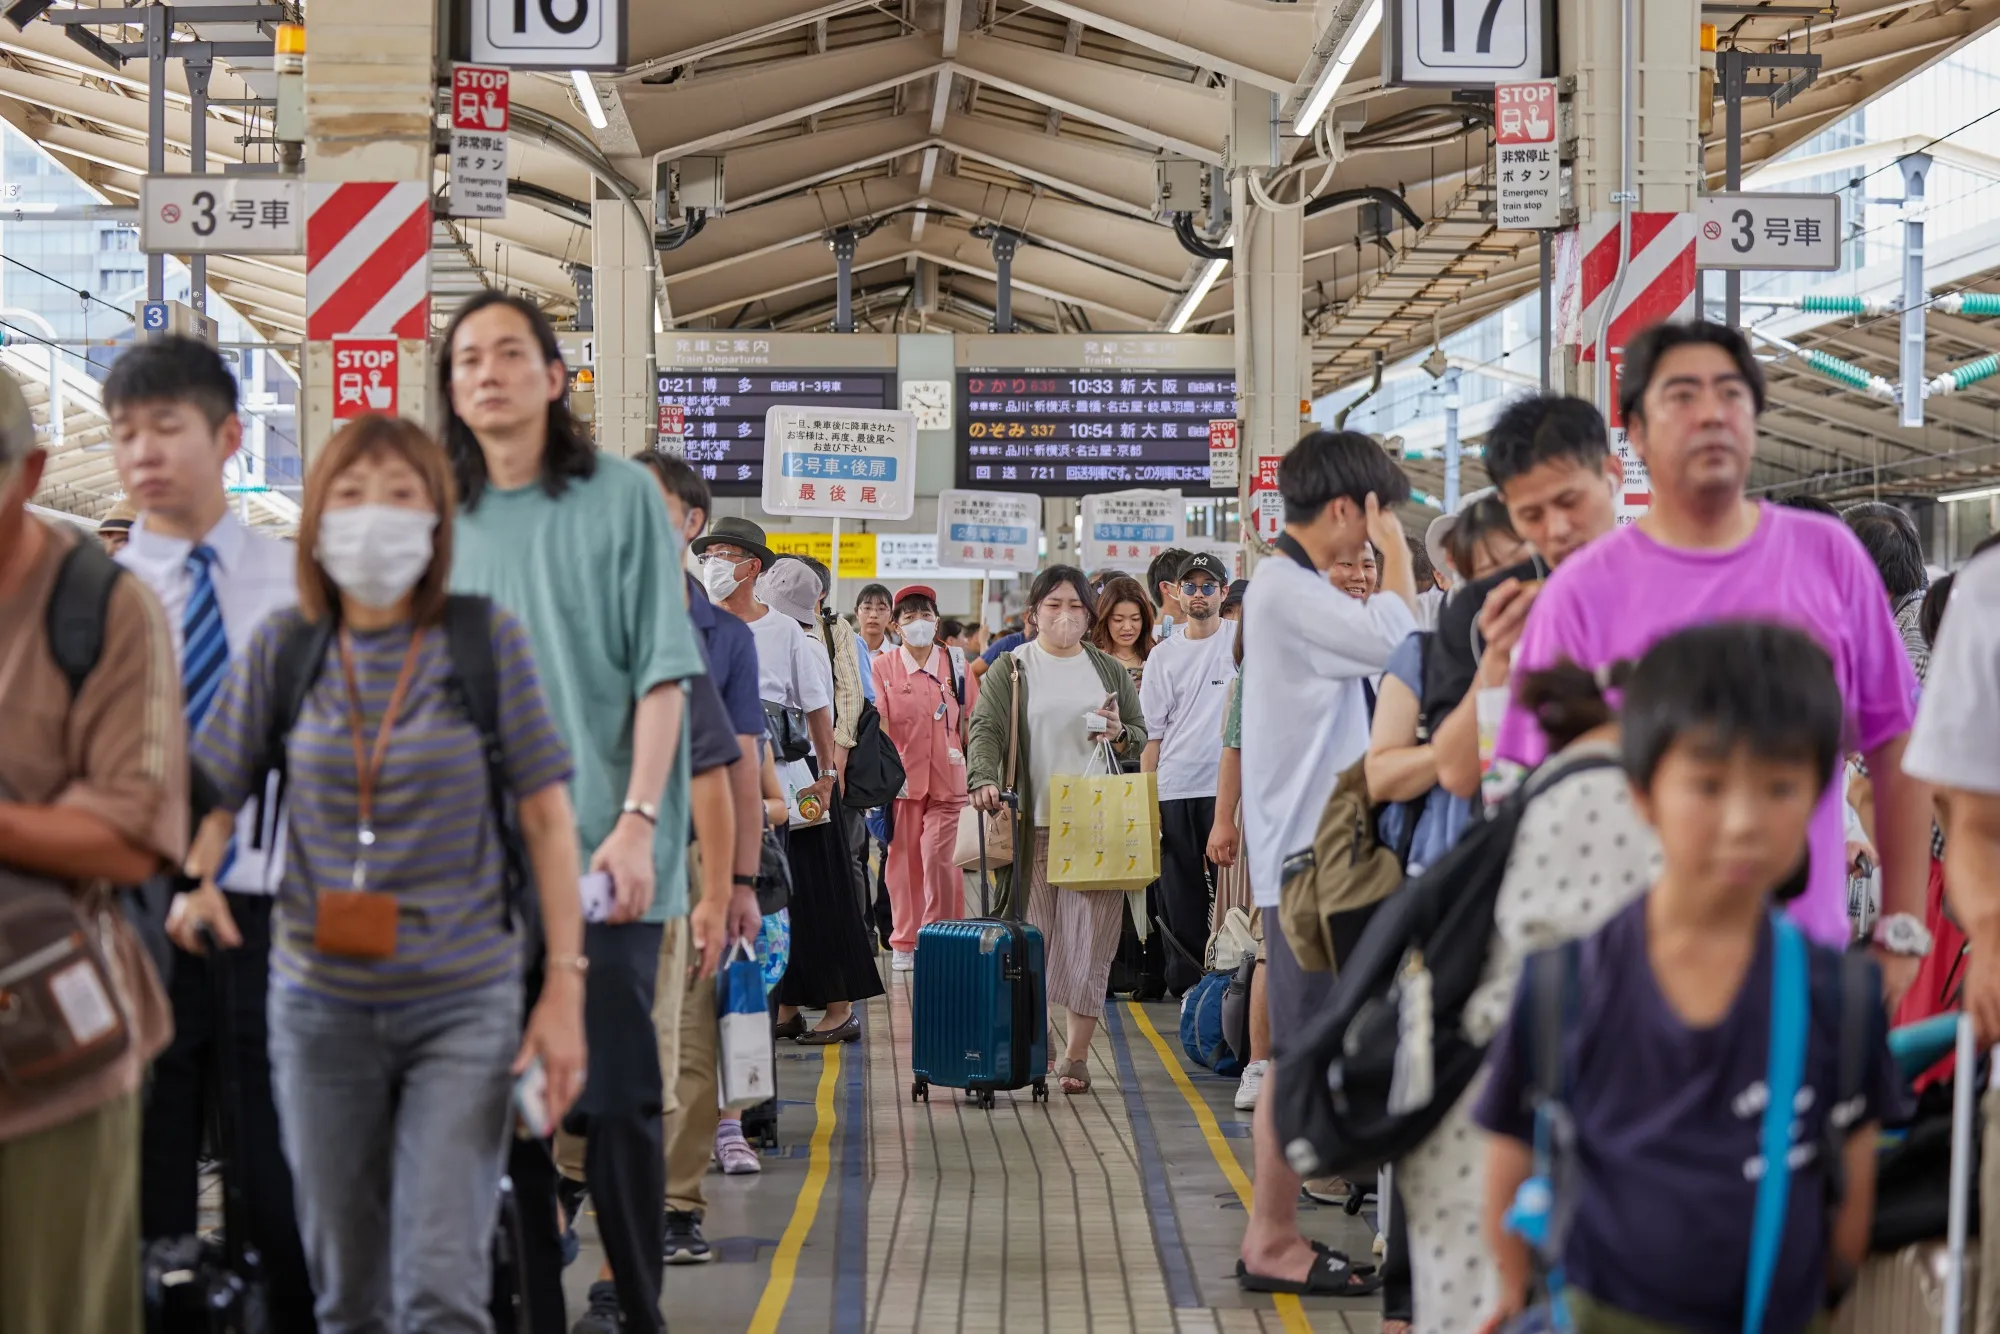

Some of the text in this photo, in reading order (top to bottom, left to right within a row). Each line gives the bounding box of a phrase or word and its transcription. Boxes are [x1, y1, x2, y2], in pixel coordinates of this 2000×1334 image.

[1441, 0, 1502, 54] 17
[457, 70, 507, 90] STOP
[1499, 86, 1551, 104] STOP
[458, 135, 504, 152] 非常停止
[457, 155, 504, 171] ボタン
[1501, 149, 1551, 164] 非常停止
[458, 174, 503, 187] Emergency
[1502, 169, 1551, 184] ボタン
[465, 189, 503, 201] train stop
[1502, 187, 1549, 200] Emergency
[191, 190, 290, 237] 3号車
[476, 203, 503, 213] button
[1502, 201, 1542, 213] train stop
[1502, 215, 1530, 224] button
[1730, 208, 1822, 254] 3号車
[148, 307, 163, 327] 3
[676, 339, 770, 353] 発車ご案内
[337, 350, 395, 368] STOP
[675, 354, 769, 365] Train Departures
[1084, 355, 1112, 365] Train
[658, 377, 693, 393] 0:21
[968, 378, 1026, 394] ひかり
[1068, 379, 1114, 394] 10:33
[660, 407, 684, 416] STOP
[968, 421, 1026, 439] のぞみ
[1030, 424, 1057, 437] 337
[1068, 422, 1113, 438] 10:54
[1210, 422, 1234, 432] STOP
[813, 441, 867, 453] お並び下さい
[792, 456, 887, 478] 2号車・後扉
[1260, 460, 1279, 469] STO
[1030, 466, 1055, 480] 721
[798, 483, 877, 503] 最後尾
